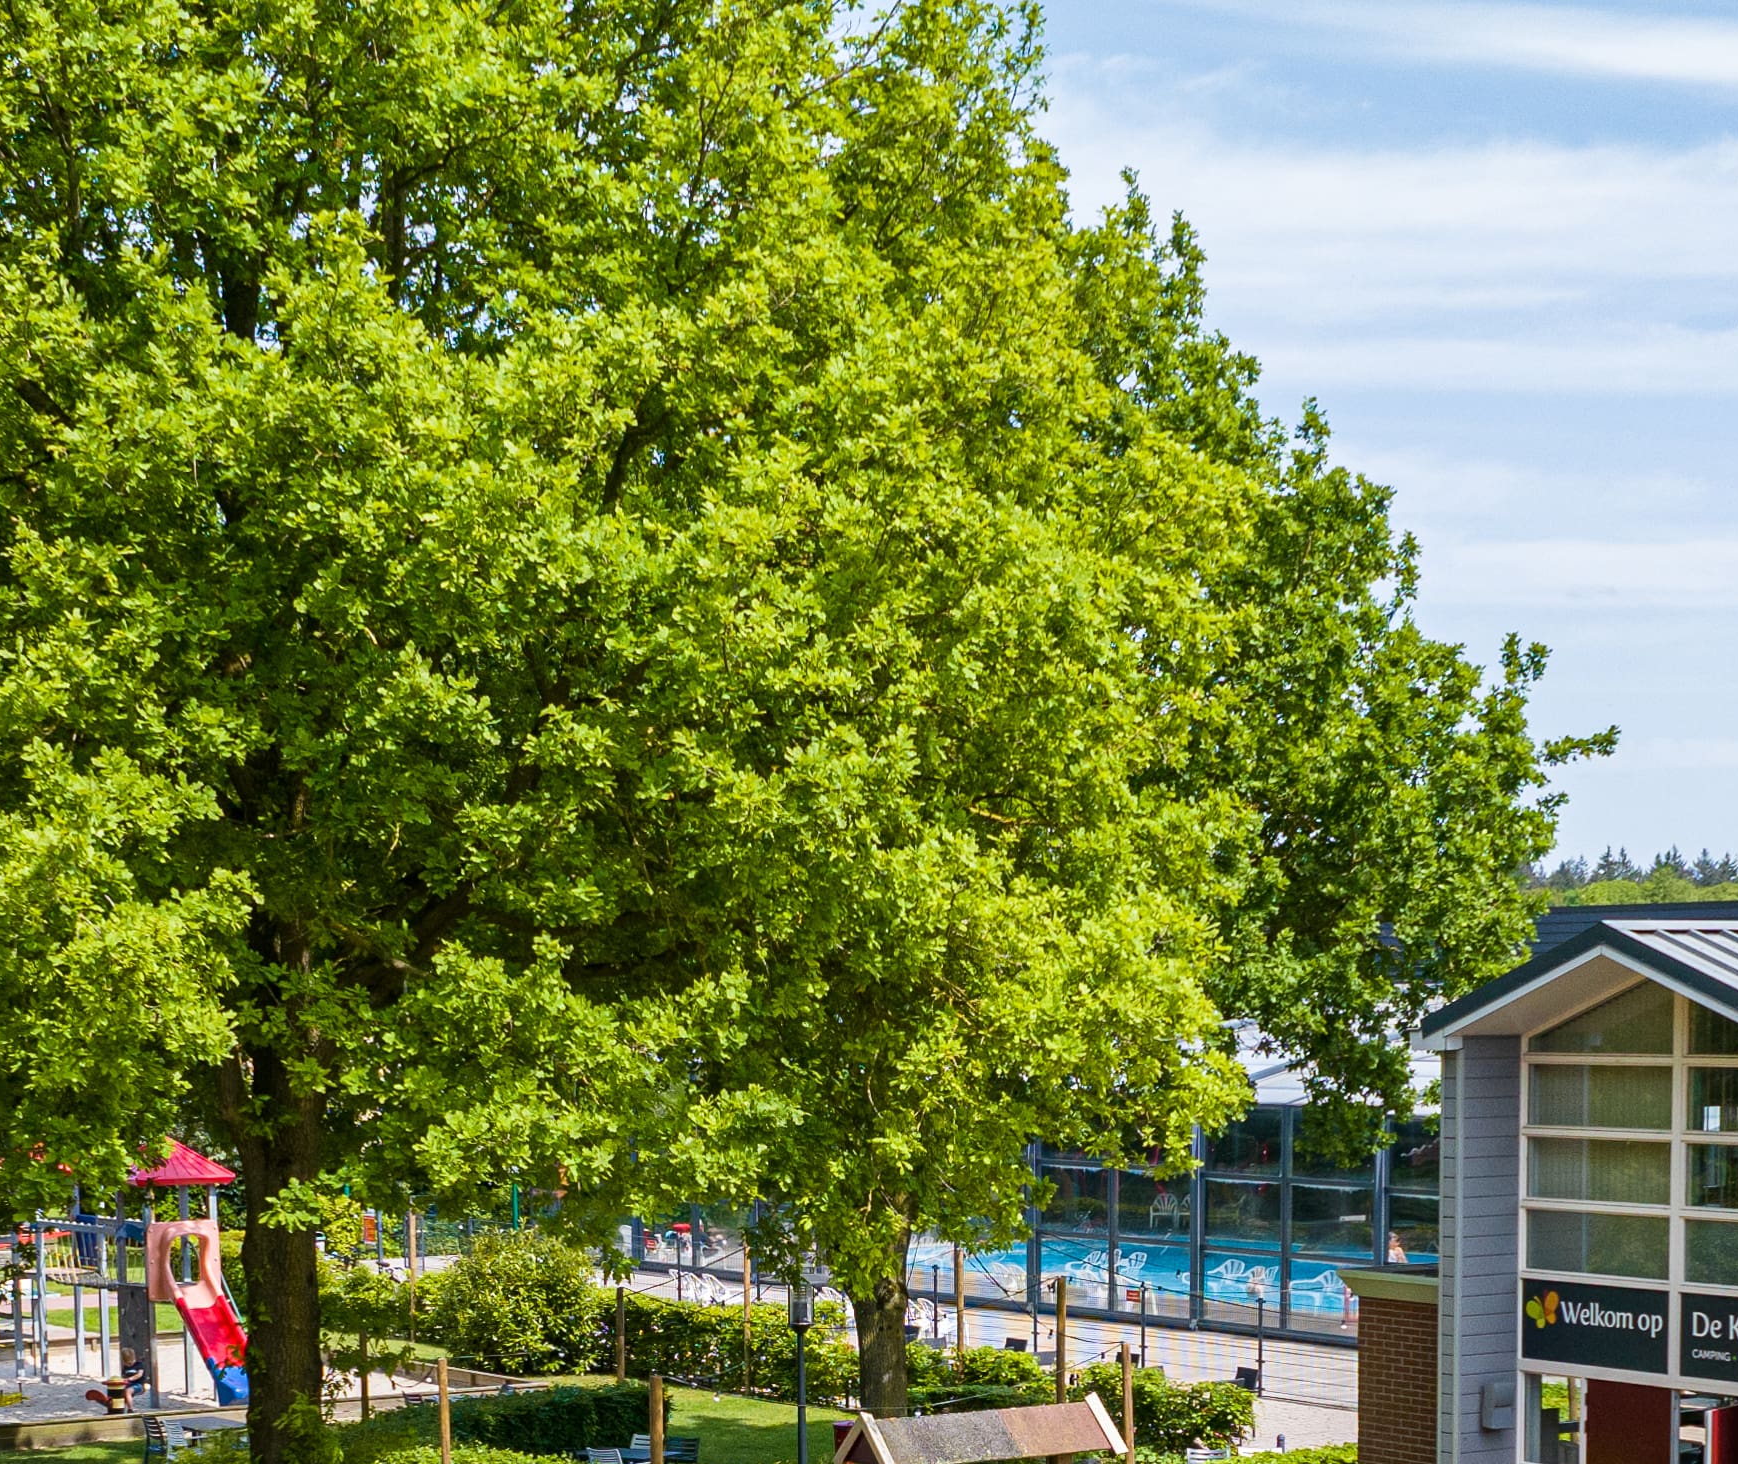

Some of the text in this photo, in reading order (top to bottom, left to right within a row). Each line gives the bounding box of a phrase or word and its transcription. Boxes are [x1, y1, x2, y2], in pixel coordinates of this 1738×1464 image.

[1560, 1301, 1663, 1338] Welkom op
[1692, 1311, 1722, 1339] De
[1692, 1348, 1731, 1362] CAMPING
